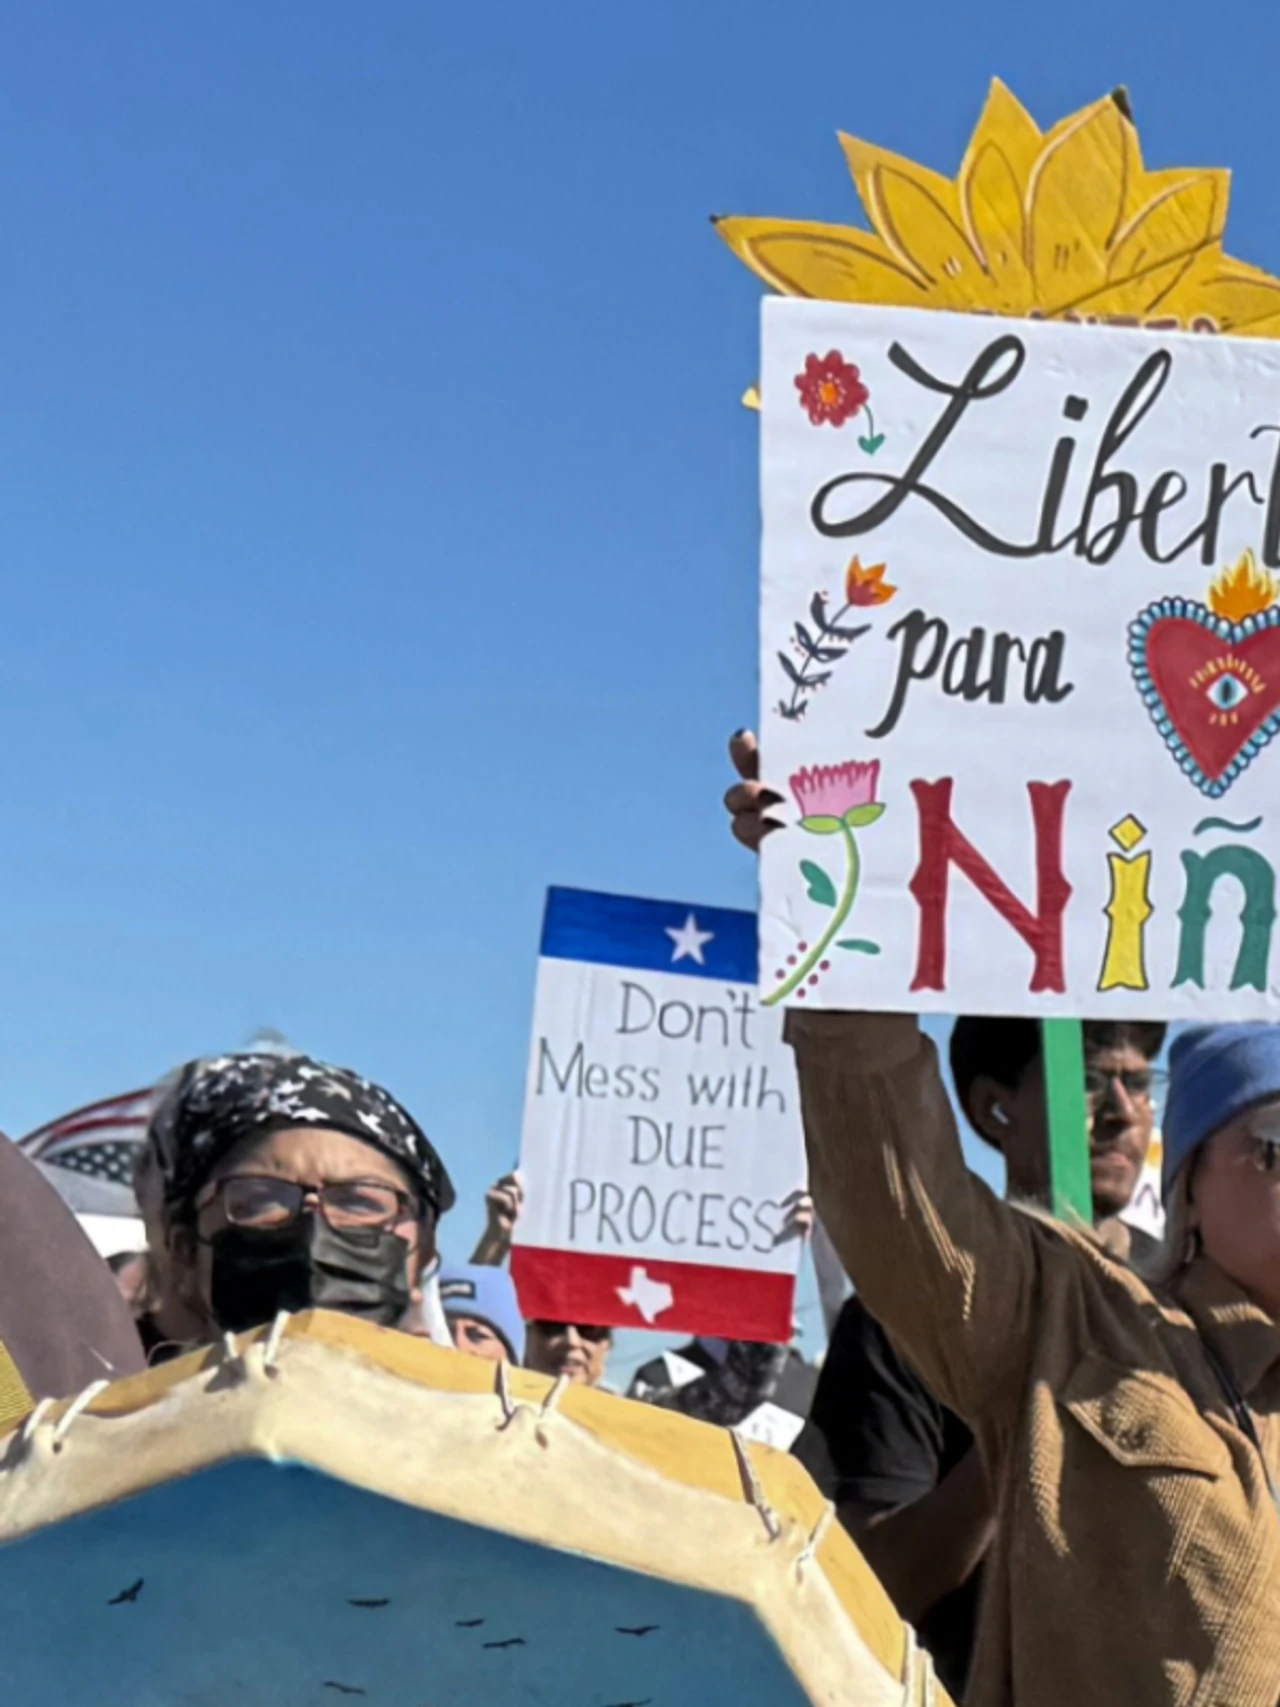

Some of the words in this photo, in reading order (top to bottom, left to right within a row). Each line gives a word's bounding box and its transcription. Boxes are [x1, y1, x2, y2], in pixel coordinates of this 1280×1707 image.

[865, 608, 1074, 739] para
[615, 978, 757, 1051] Don't
[534, 1035, 660, 1103] Mess
[686, 1062, 786, 1114] with
[626, 1114, 727, 1171] DUE
[568, 1178, 779, 1254] PROCESS
